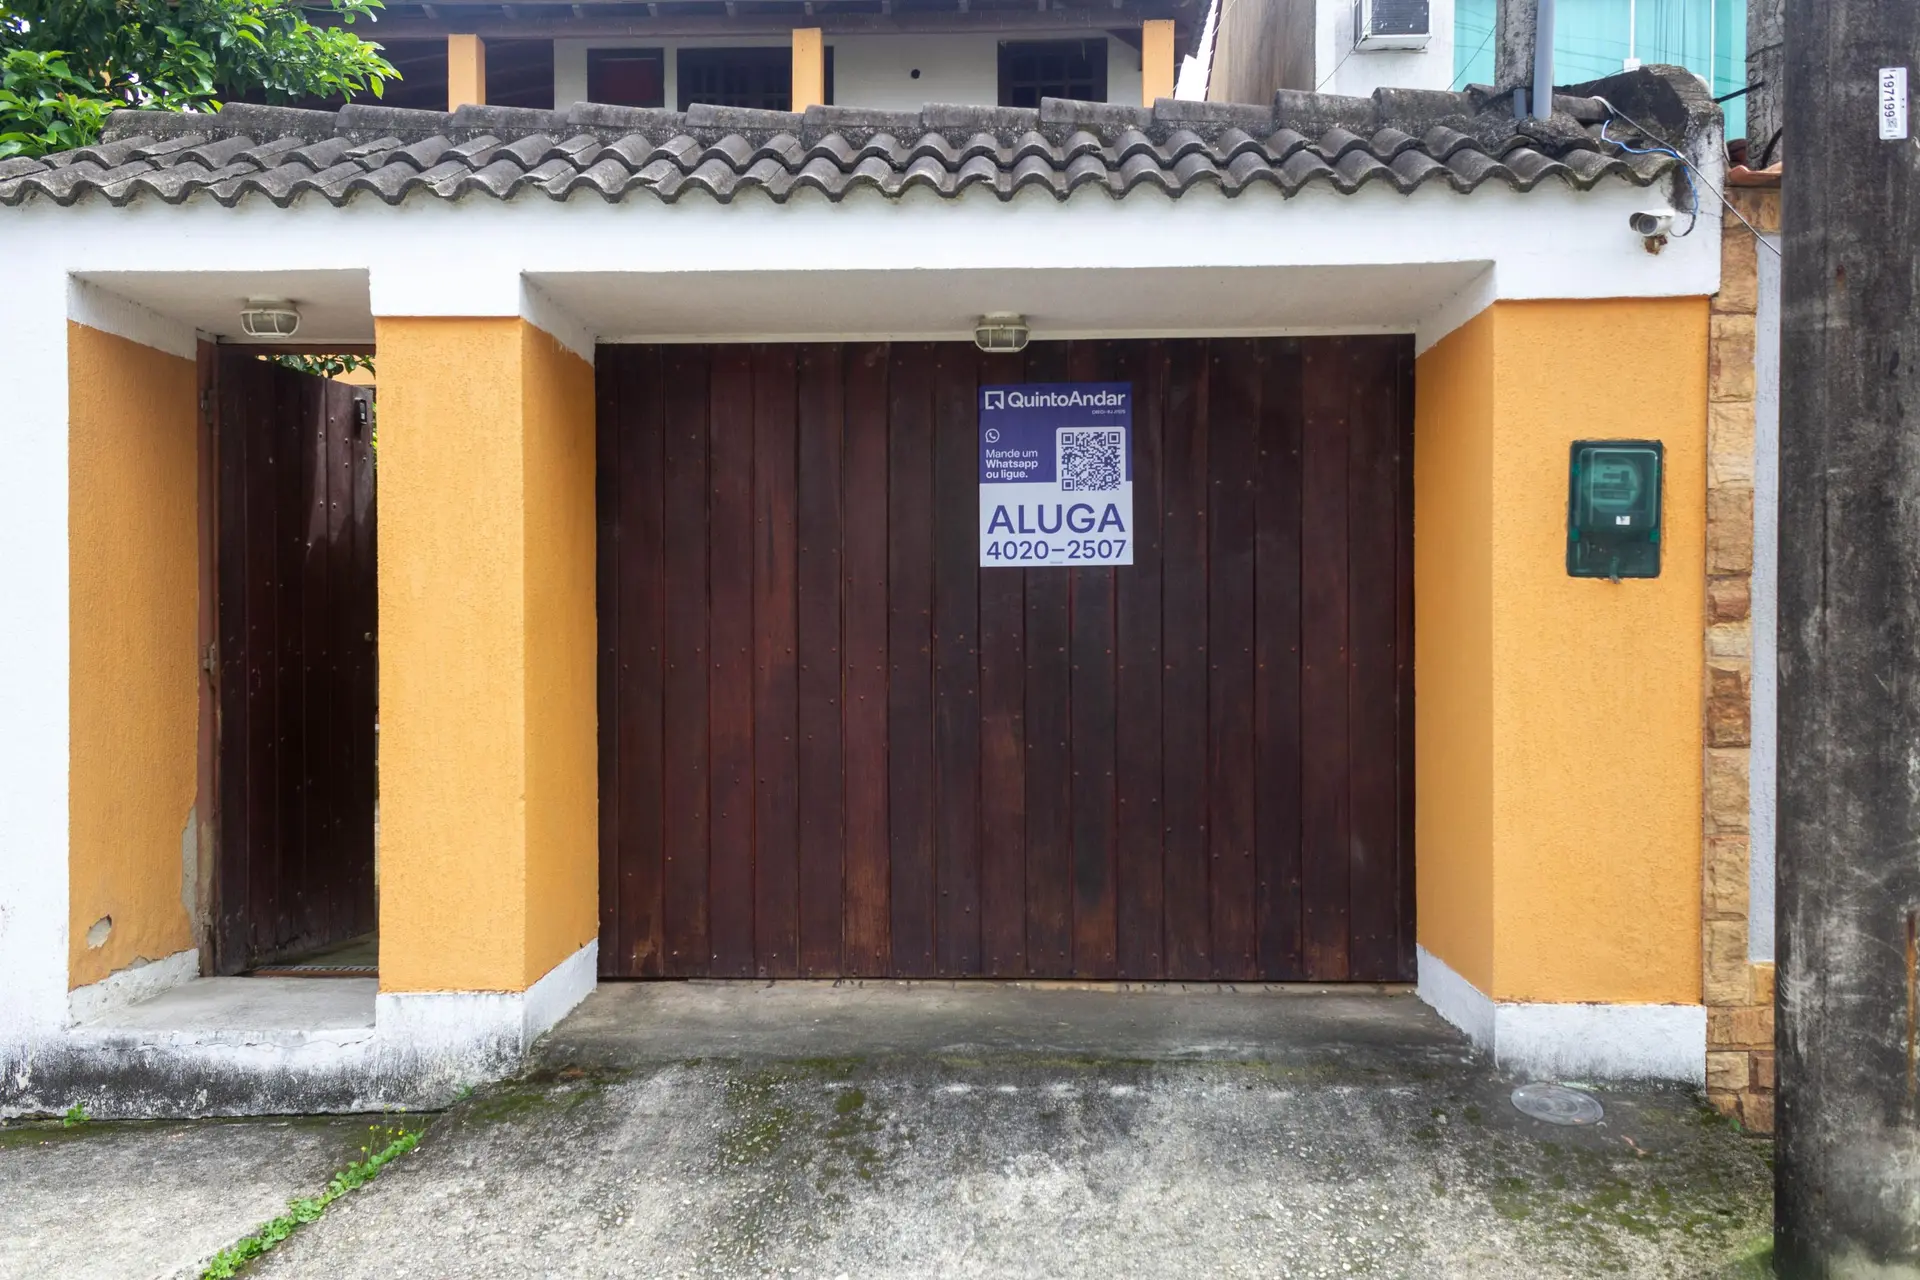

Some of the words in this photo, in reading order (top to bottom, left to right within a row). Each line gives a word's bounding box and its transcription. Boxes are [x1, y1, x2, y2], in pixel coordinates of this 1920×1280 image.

[1883, 73, 1896, 118] 197199
[1007, 390, 1126, 409] QuintoAndar
[985, 448, 1021, 458] Mande
[1022, 450, 1039, 458] um
[985, 459, 1039, 470] Whatsapp
[985, 471, 999, 479] ou
[1000, 469, 1029, 481] ligue.
[987, 503, 1126, 534] ALUGA
[986, 539, 1127, 561] 4020-2507
